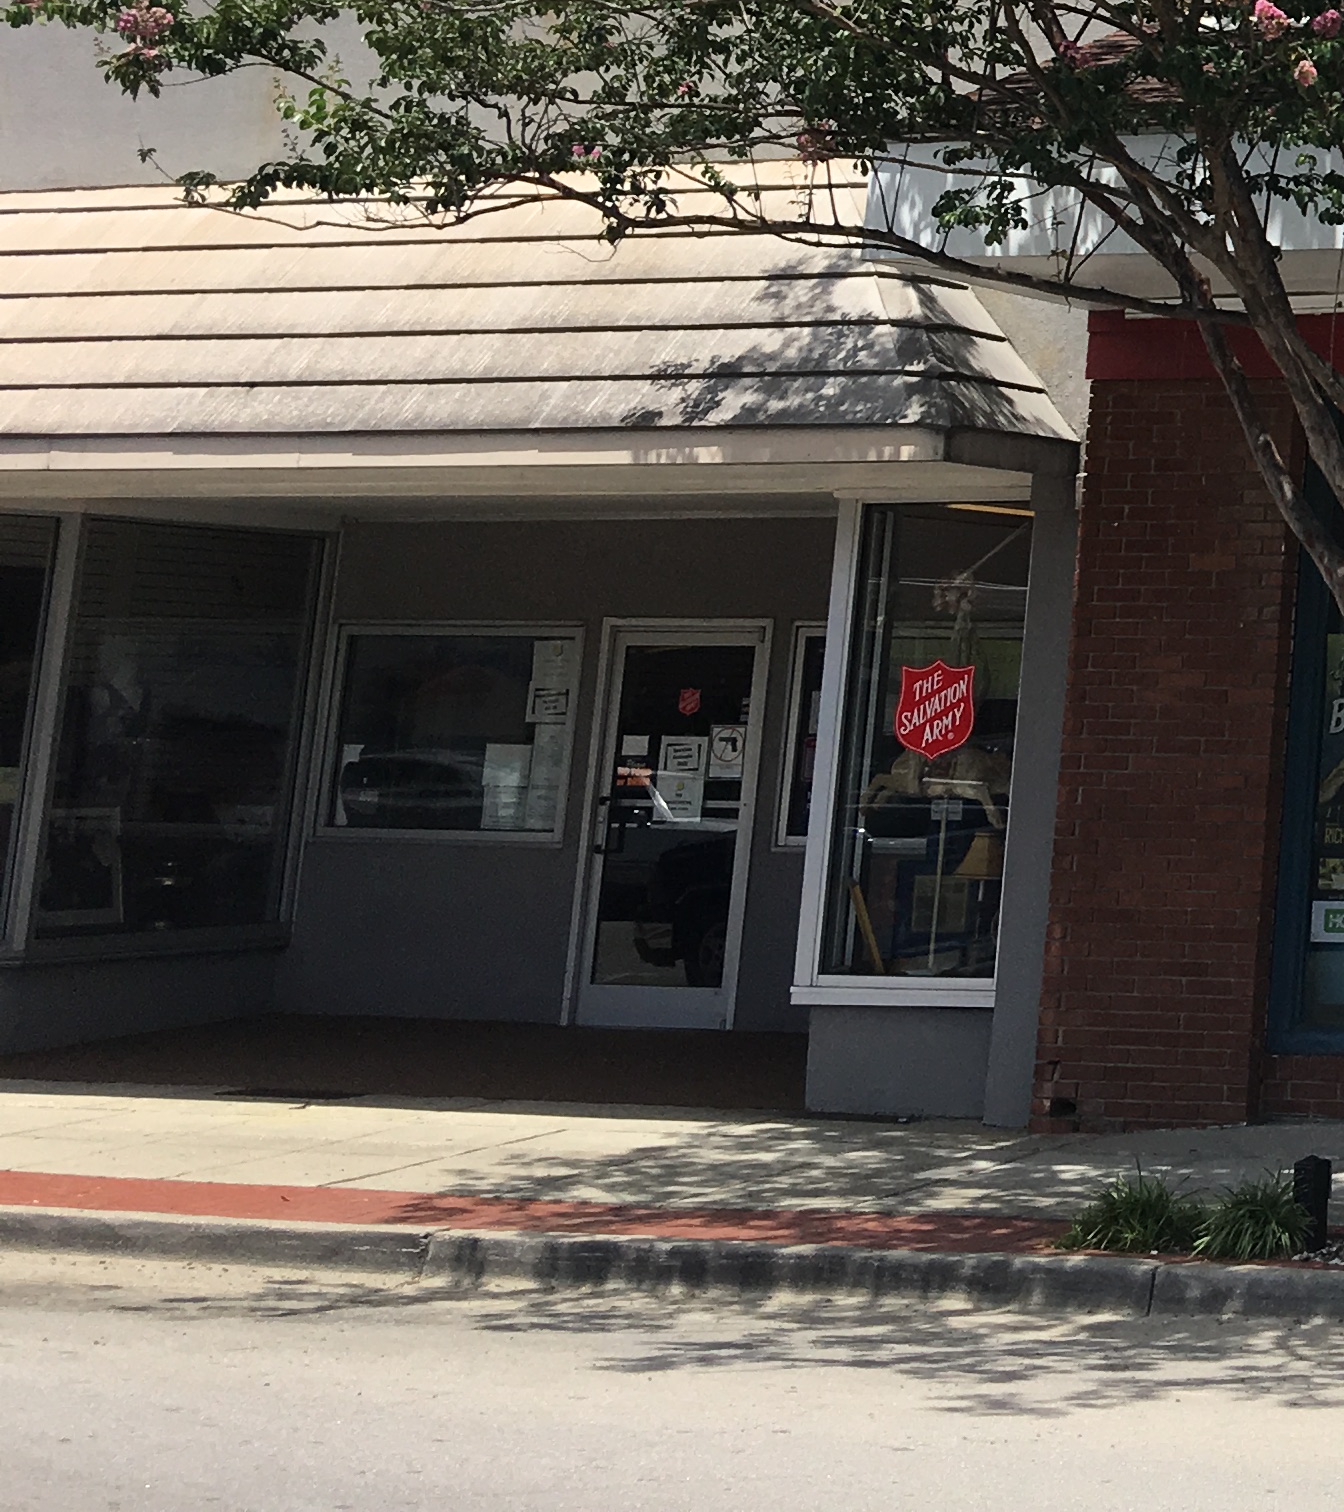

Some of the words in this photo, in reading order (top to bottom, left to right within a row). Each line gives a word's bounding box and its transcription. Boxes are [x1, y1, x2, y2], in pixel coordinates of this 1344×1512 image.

[900, 674, 968, 735] SALVATION
[912, 669, 943, 701] THE
[921, 702, 965, 748] ARMY
